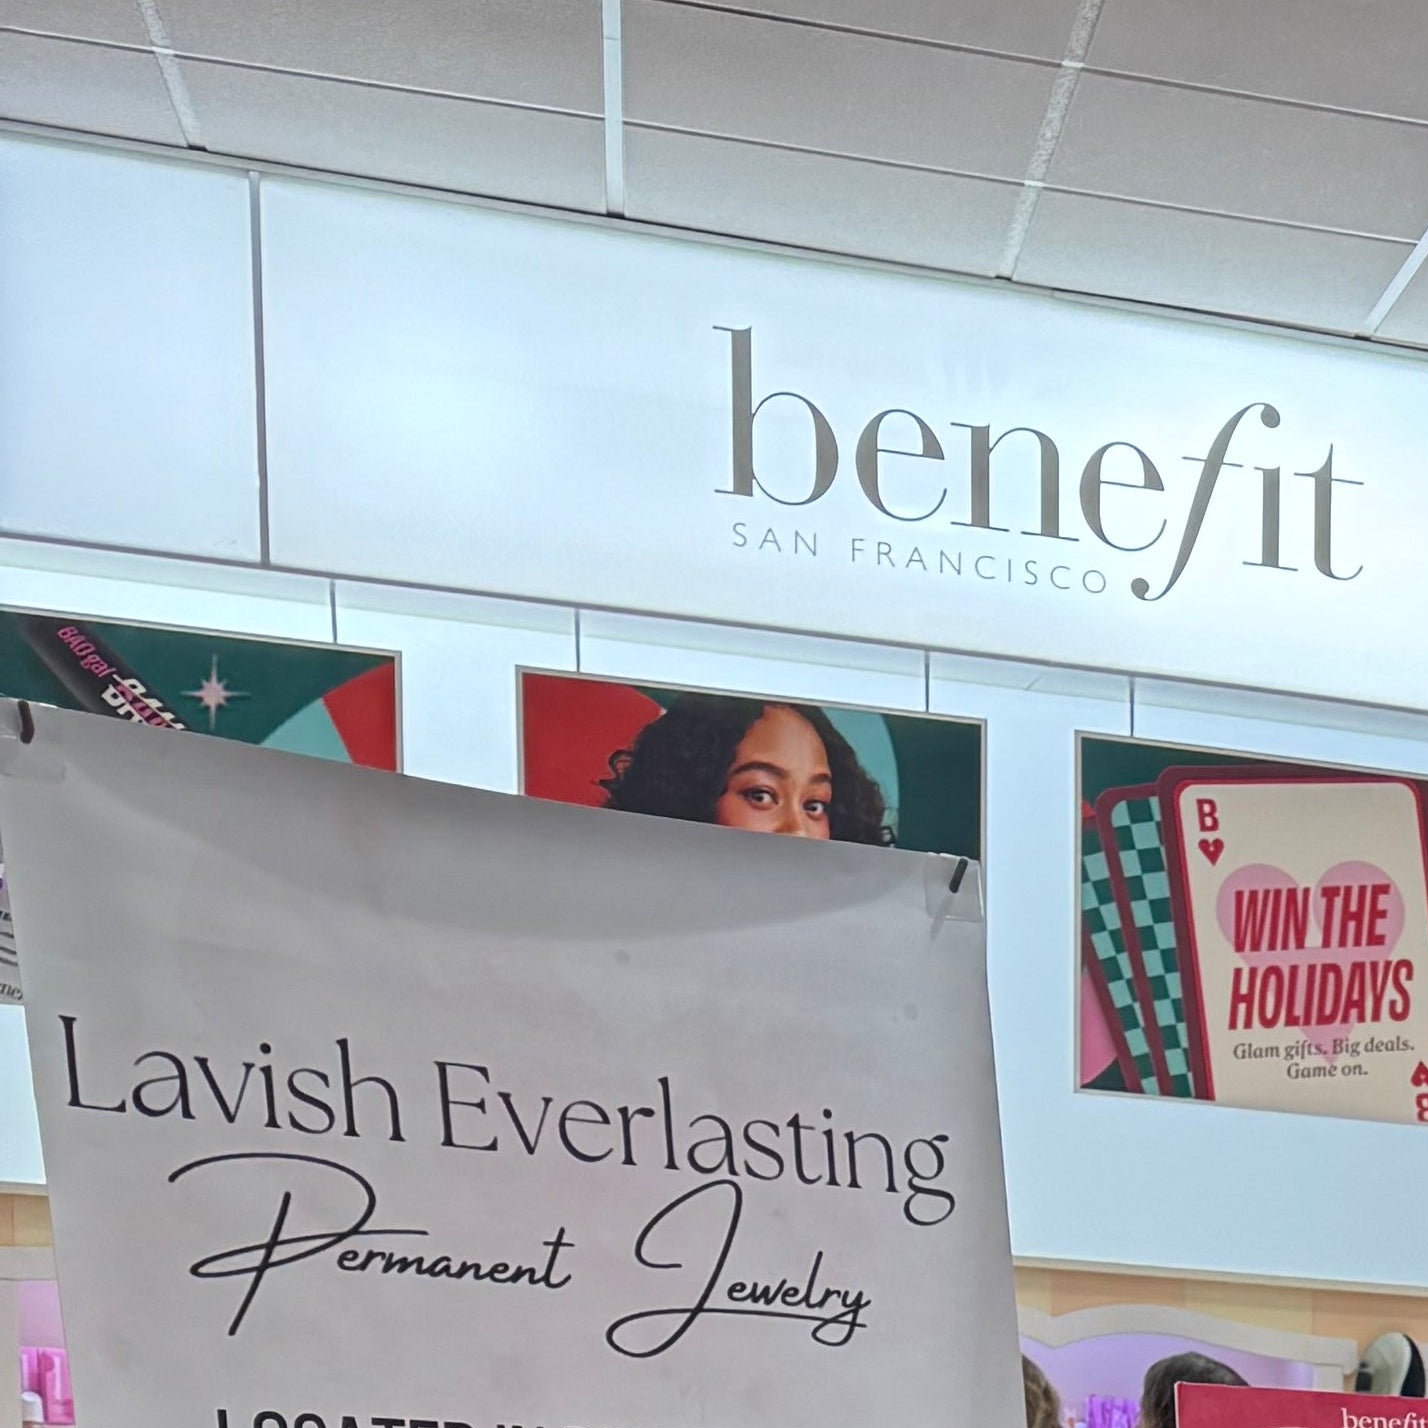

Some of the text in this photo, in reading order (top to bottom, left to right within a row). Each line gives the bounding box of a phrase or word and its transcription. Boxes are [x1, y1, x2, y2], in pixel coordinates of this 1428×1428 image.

[713, 325, 1364, 601] benefit
[732, 522, 1107, 594] SAN FRANCISCO
[1197, 798, 1219, 832] B
[1234, 884, 1391, 953] WIN THE
[1228, 959, 1414, 1030] HOLIDAYS
[1234, 1036, 1416, 1061] Glam gifts. Big deals.
[1286, 1062, 1369, 1080] Game on.
[59, 1014, 956, 1227] Lavish Everlasting
[168, 1153, 871, 1358] Permanent Jewelry
